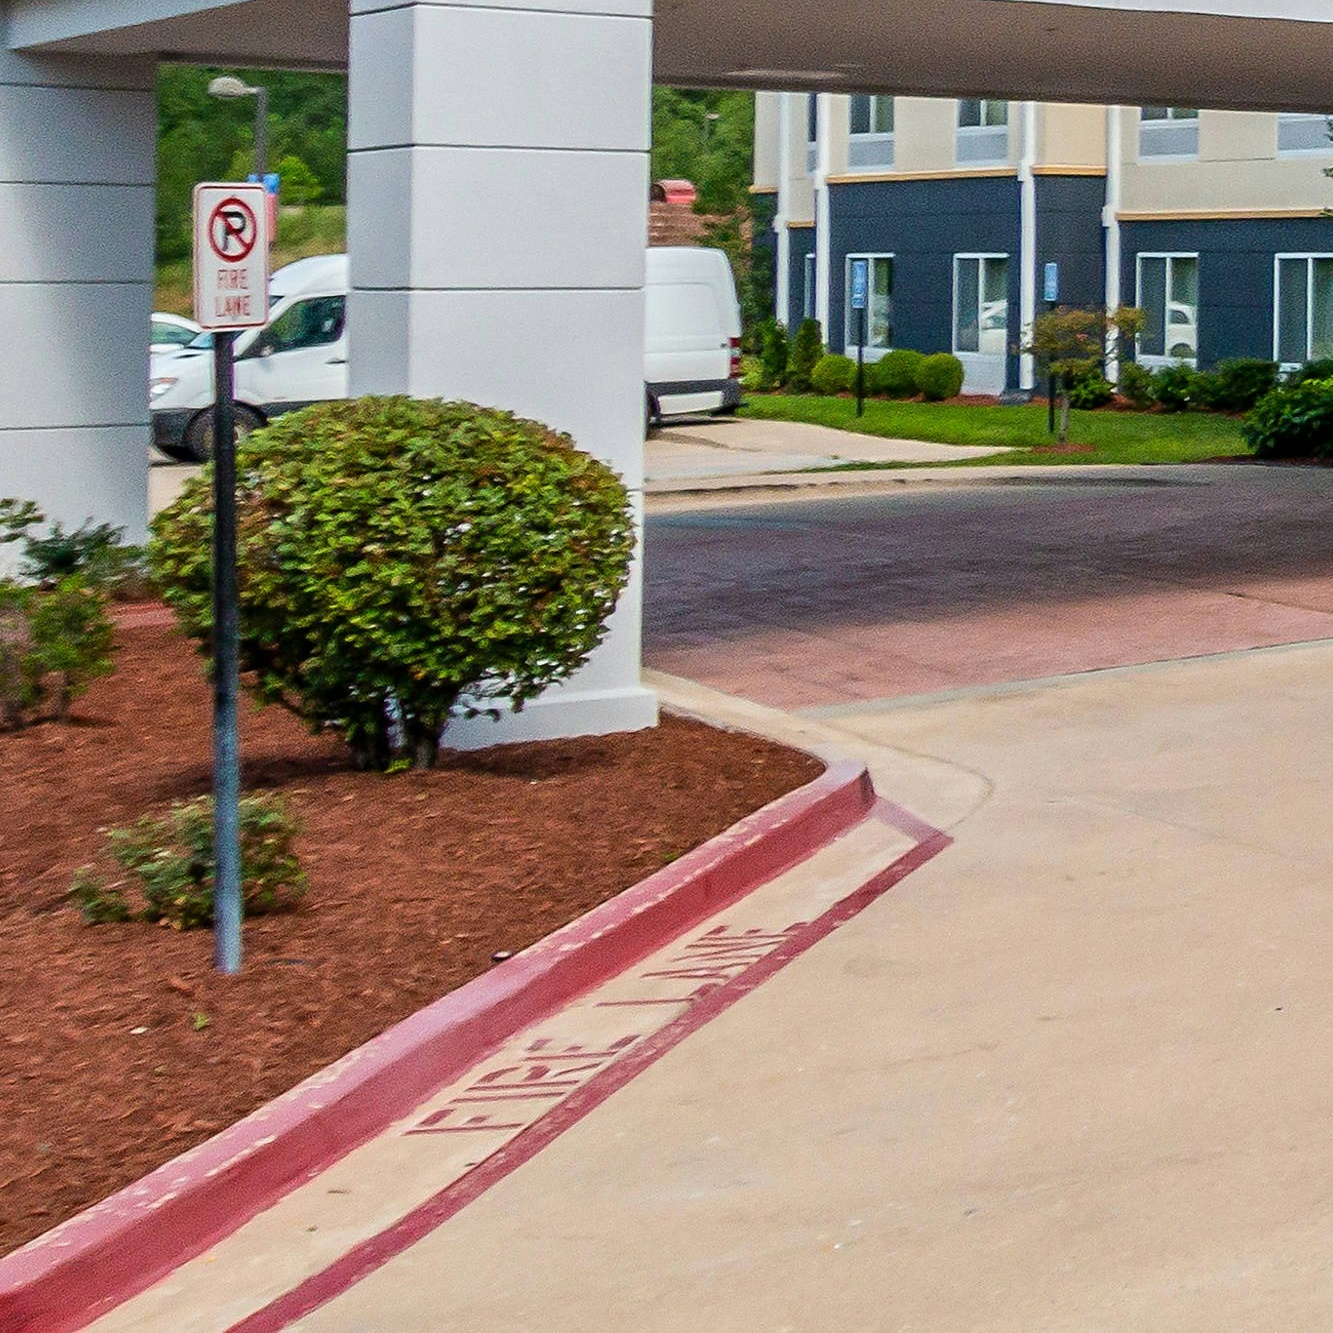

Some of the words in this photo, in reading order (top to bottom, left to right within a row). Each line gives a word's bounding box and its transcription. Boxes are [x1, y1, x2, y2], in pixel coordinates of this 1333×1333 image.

[217, 268, 249, 290] FIRE
[214, 294, 251, 317] LANE
[401, 1033, 643, 1137] FIRE
